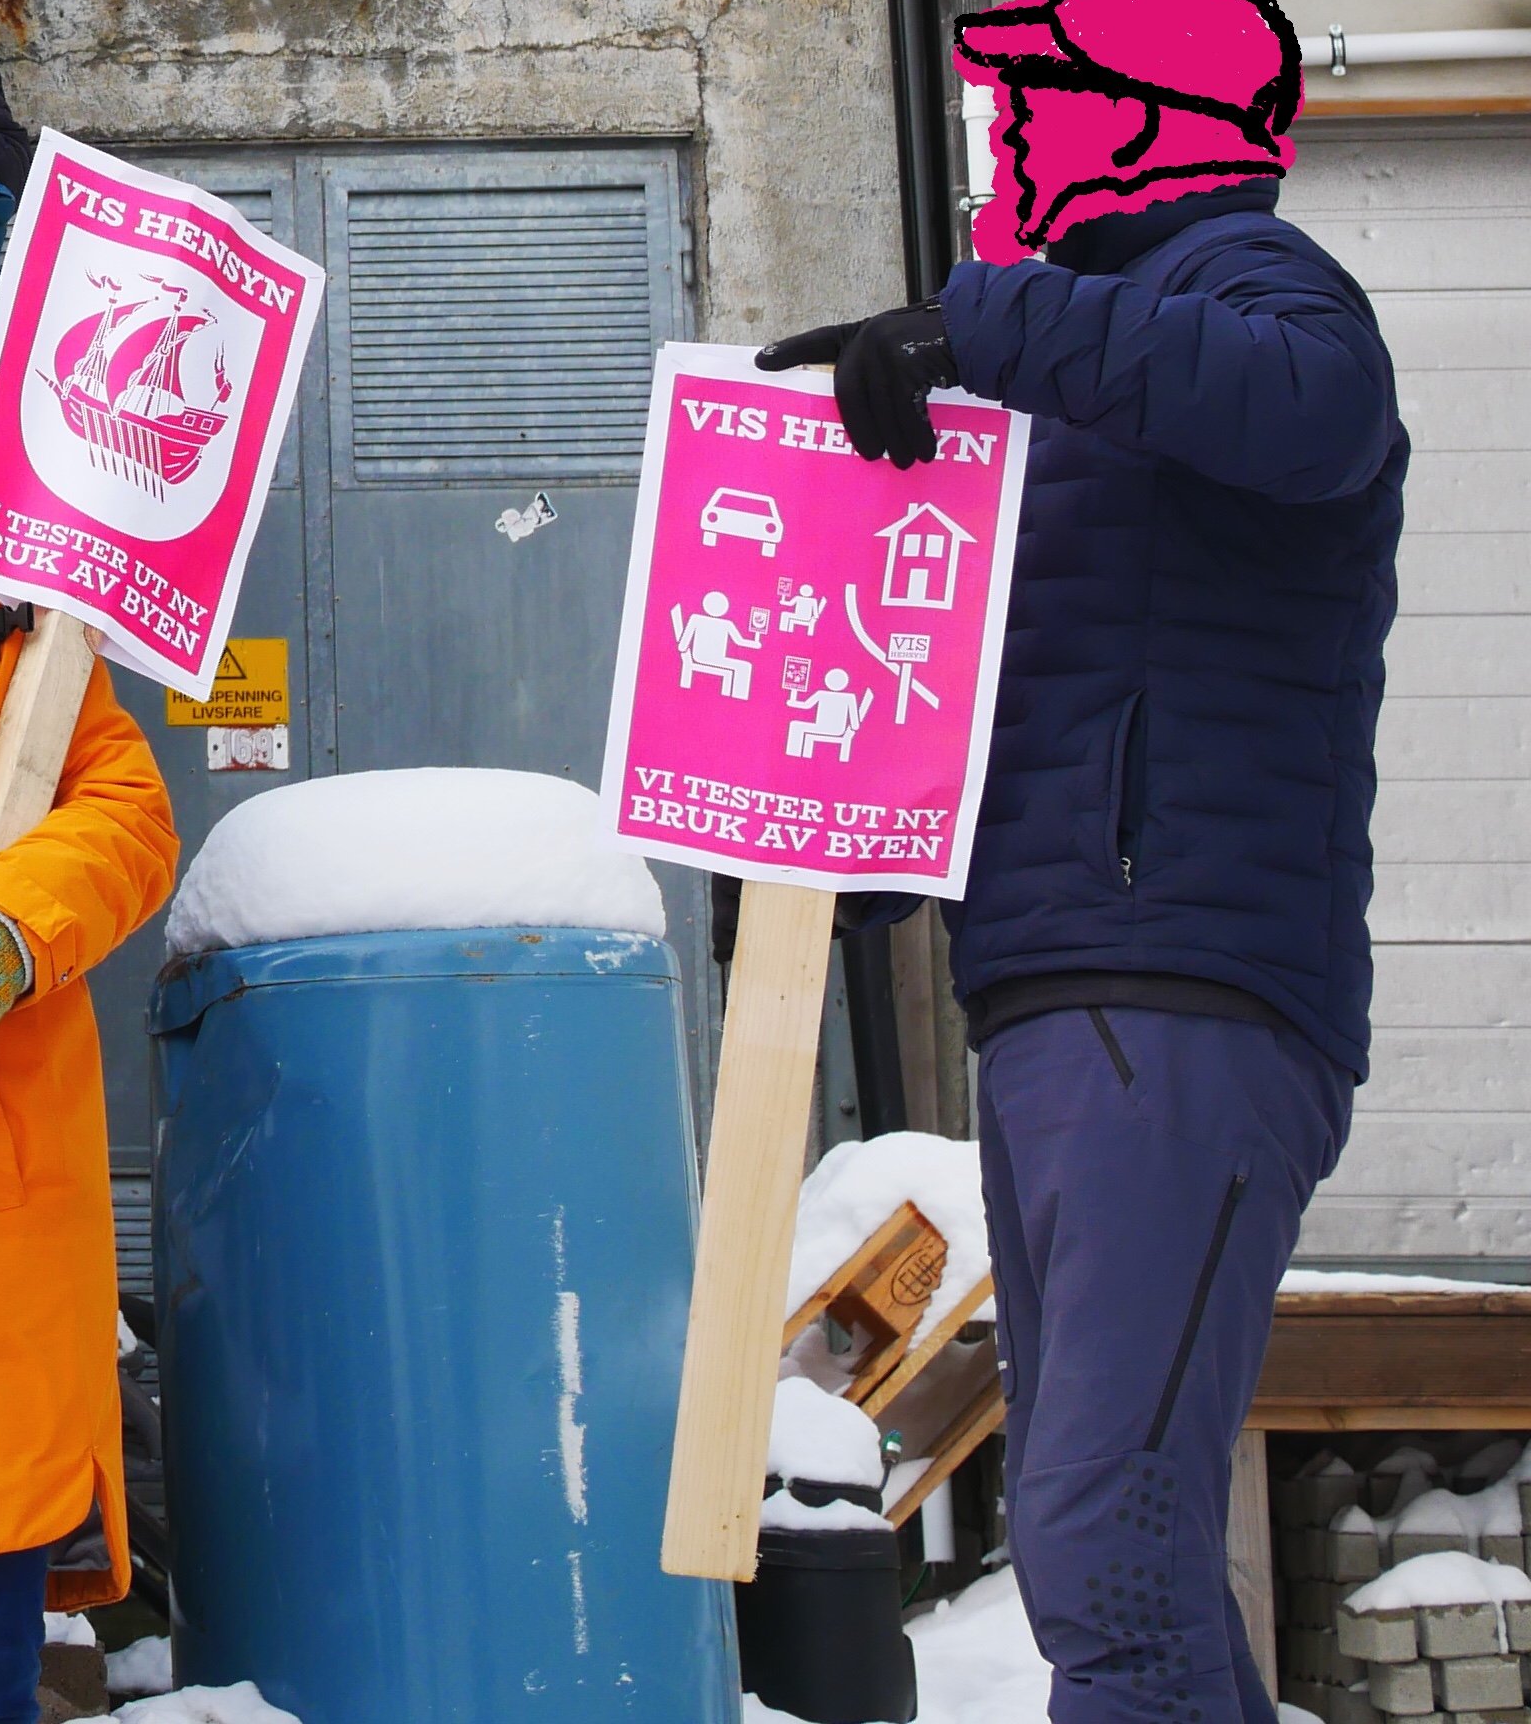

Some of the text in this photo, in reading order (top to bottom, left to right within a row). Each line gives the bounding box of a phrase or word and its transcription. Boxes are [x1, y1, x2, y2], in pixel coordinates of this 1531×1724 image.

[57, 174, 295, 314] VIS HENSYN
[681, 399, 997, 465] VIS HEYN
[7, 510, 128, 573] TESTER
[135, 561, 168, 598] UT
[168, 588, 207, 625] NY
[68, 560, 120, 595] AV
[121, 585, 200, 655] BYEN
[892, 637, 928, 651] VIS
[192, 706, 263, 719] LIVSFARE
[629, 795, 943, 860] BRUK AV BYEN
[635, 767, 948, 829] VI TESTER UT NY
